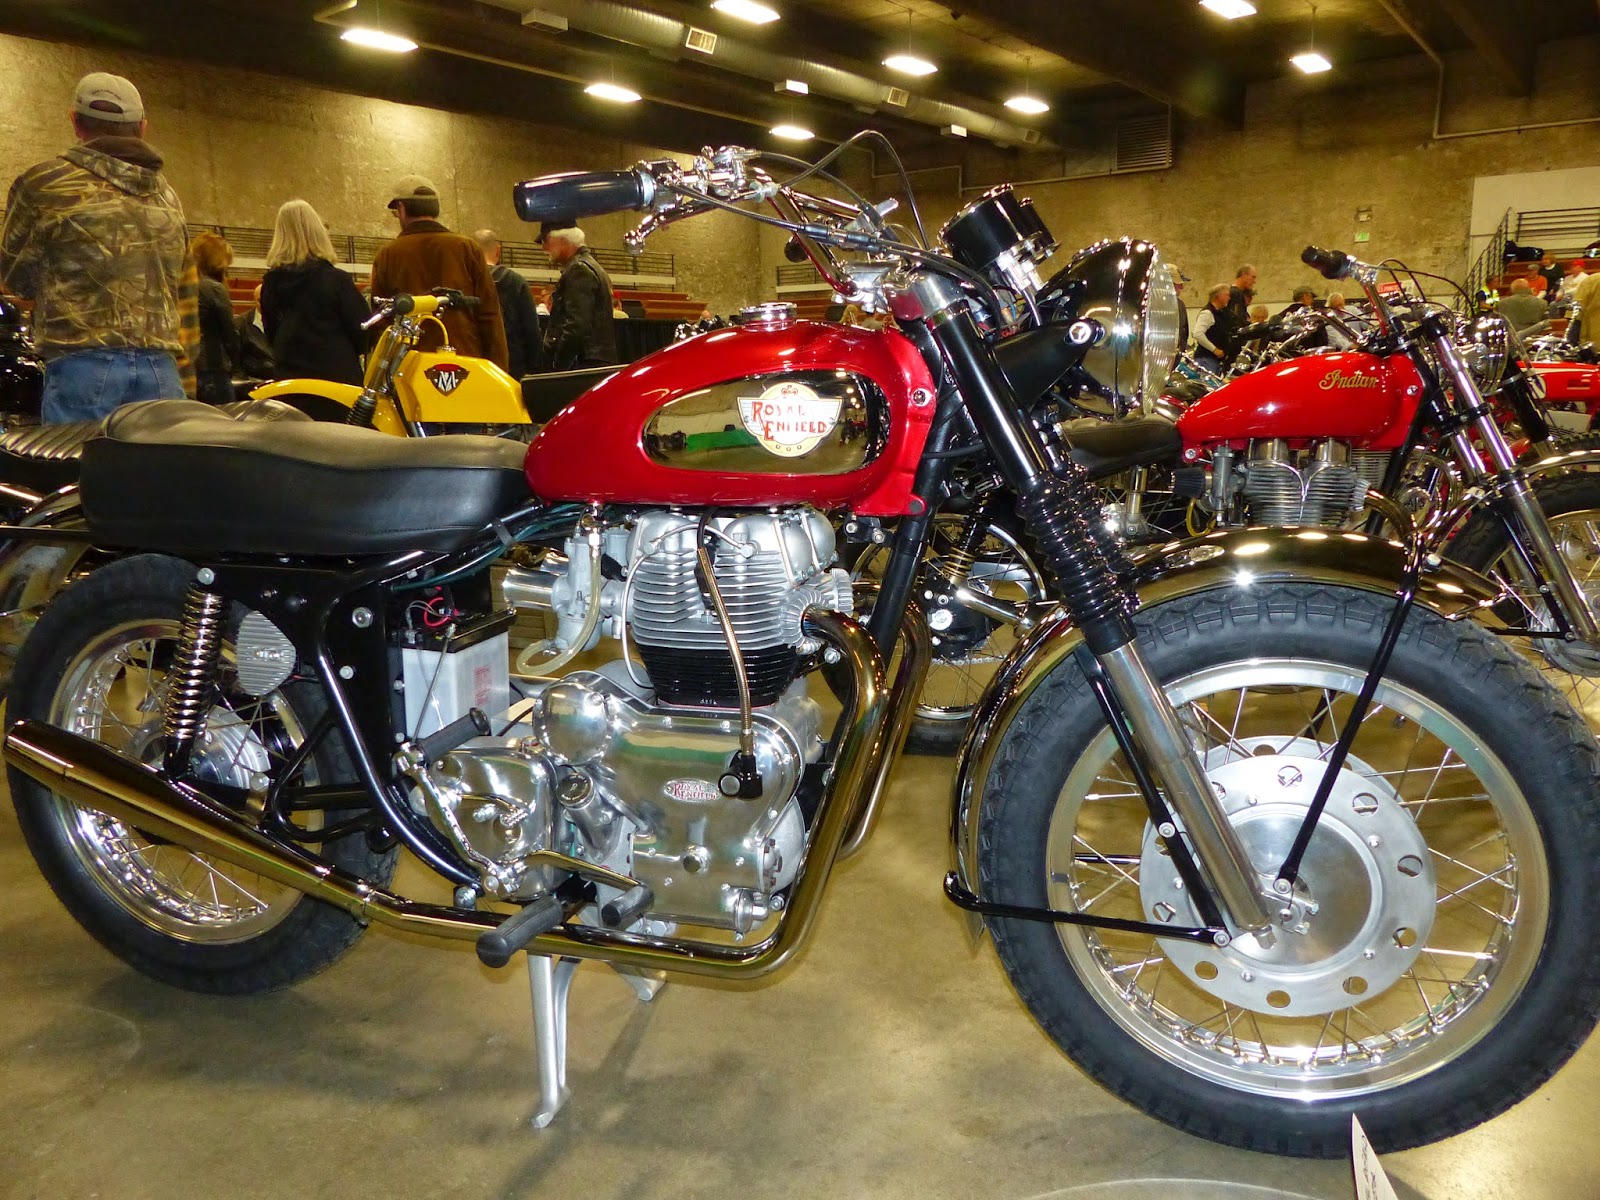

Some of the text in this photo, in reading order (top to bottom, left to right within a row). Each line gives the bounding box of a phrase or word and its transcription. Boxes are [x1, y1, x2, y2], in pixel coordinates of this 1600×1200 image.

[1319, 369, 1378, 390] Indian
[751, 400, 806, 430] ROYAL
[763, 421, 828, 441] ENFIELD
[673, 782, 704, 797] ROYAL
[680, 790, 718, 800] ENFIELD
